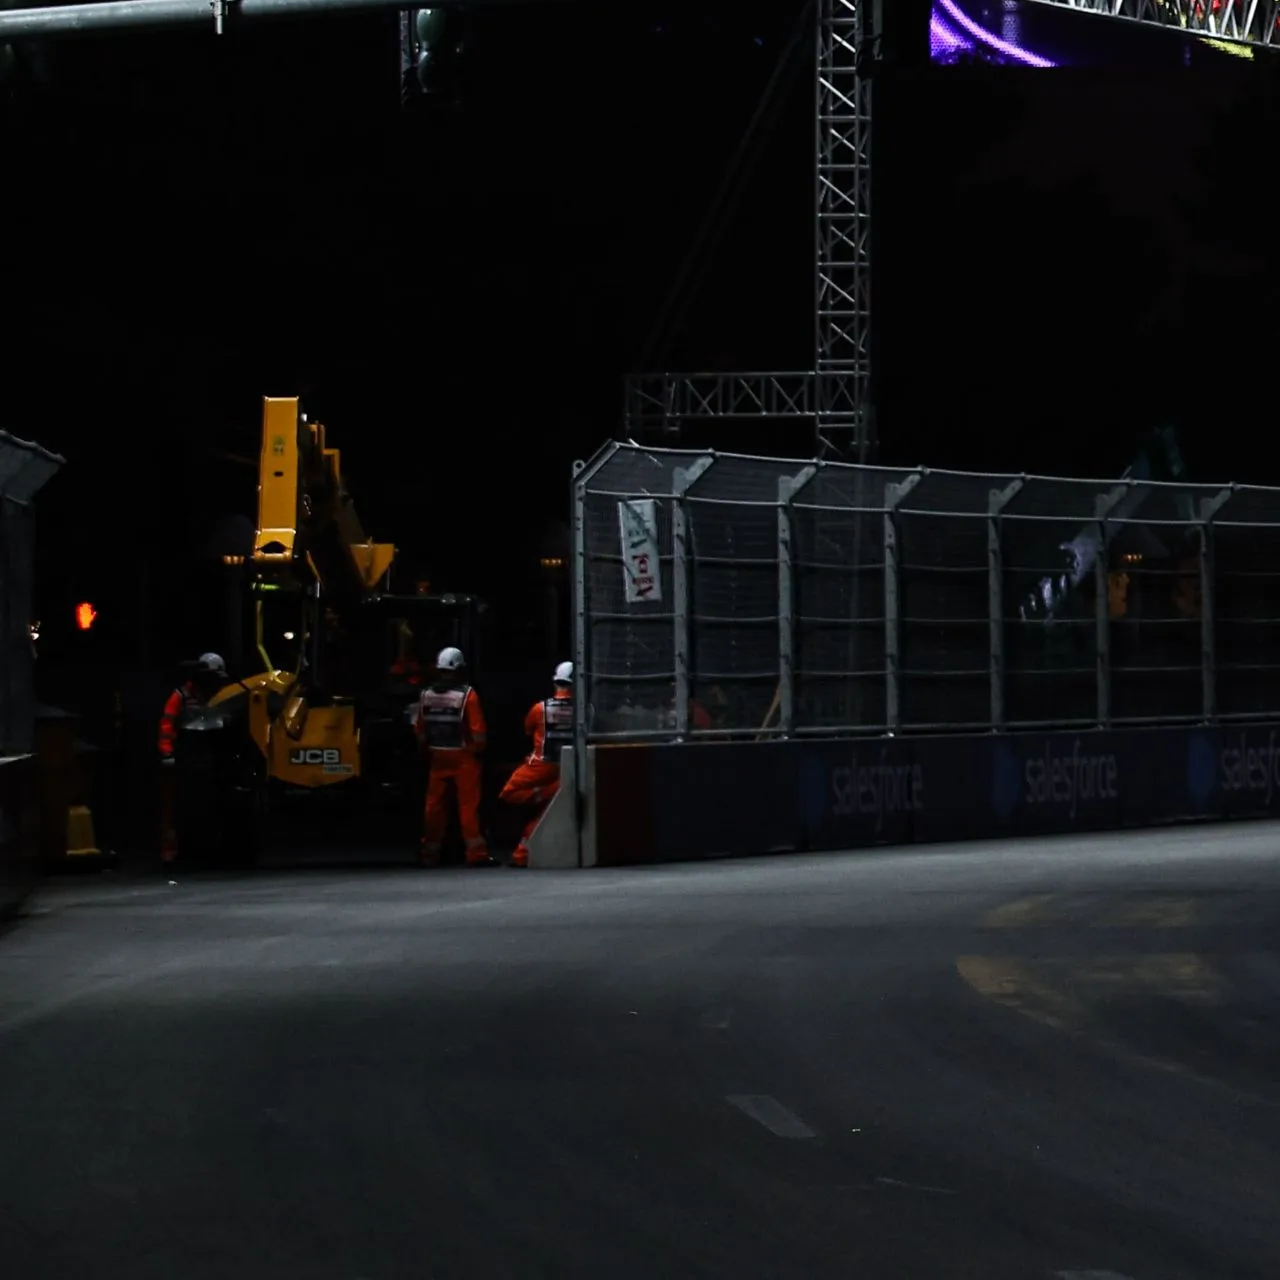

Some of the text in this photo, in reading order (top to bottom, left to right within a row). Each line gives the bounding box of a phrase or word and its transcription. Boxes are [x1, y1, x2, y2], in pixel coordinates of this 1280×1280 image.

[290, 749, 340, 764] JCB
[832, 747, 924, 834] salesforce
[1025, 736, 1119, 820] salesforce
